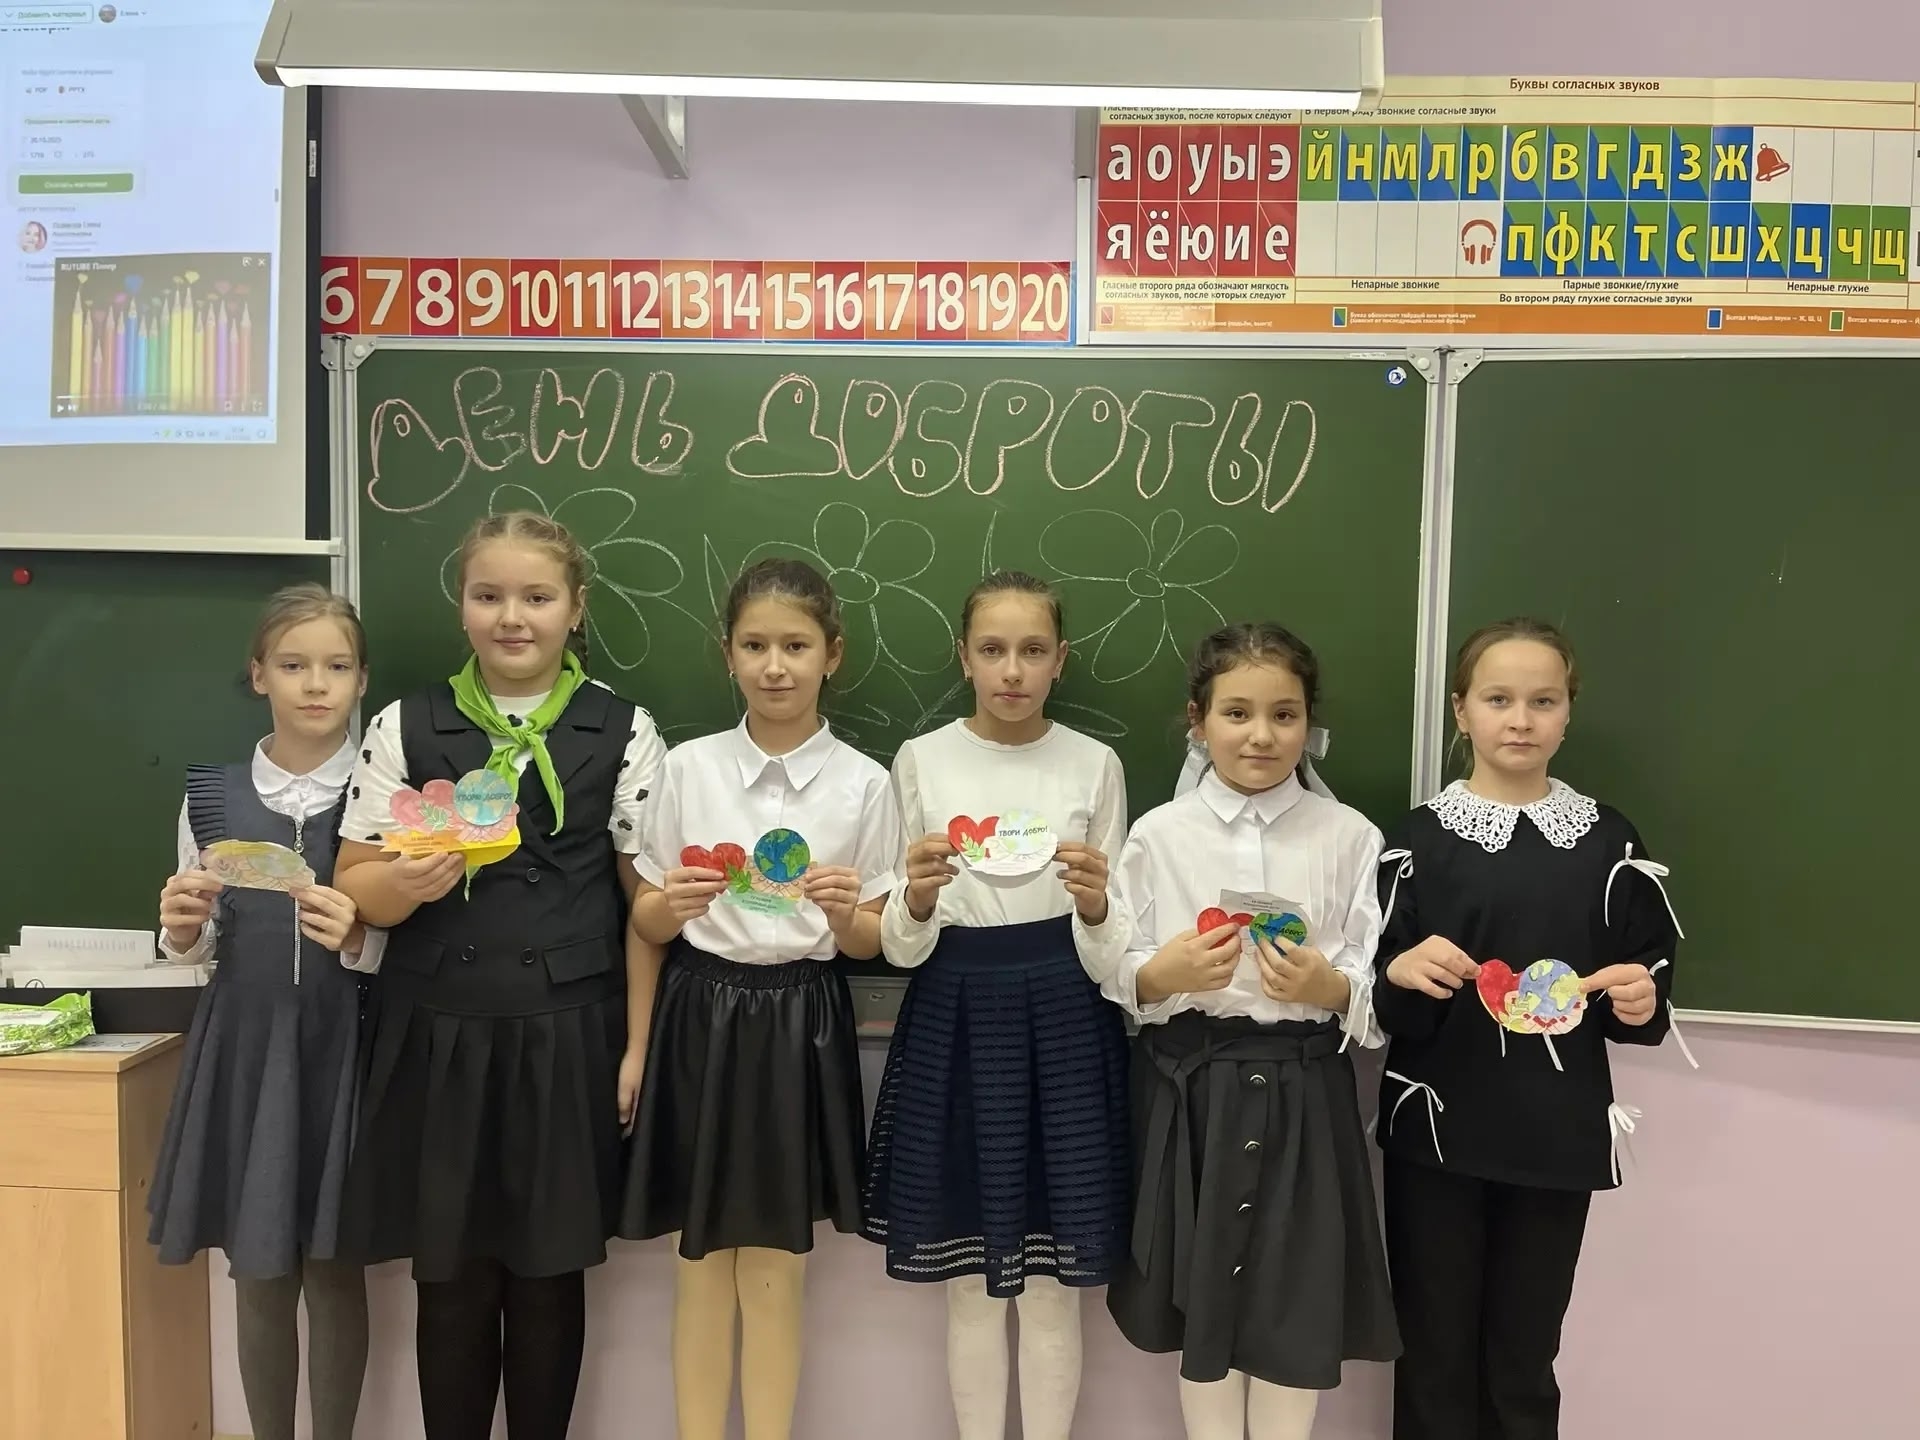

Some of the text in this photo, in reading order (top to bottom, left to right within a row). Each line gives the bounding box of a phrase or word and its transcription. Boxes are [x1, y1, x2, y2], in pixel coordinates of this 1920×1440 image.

[1510, 78, 1660, 93] Буквы согласных звуков
[1155, 113, 1187, 122] звуков,
[1189, 112, 1214, 120] после
[1217, 112, 1253, 121] которых
[1255, 112, 1292, 121] следуют
[1377, 108, 1415, 116] звонкие
[1418, 107, 1467, 116] согласные
[1469, 107, 1496, 117] звуки
[1306, 129, 1749, 195] й н м л р б в г д з ж
[1106, 143, 1292, 196] а о у ы э
[1106, 210, 1290, 262] я ё ю и е
[1507, 224, 1535, 262] п
[1545, 211, 1580, 276] ф
[1589, 224, 1618, 262] к
[1633, 224, 1659, 262] т
[1676, 224, 1698, 262] с
[1710, 225, 1746, 263] ш
[1756, 225, 1784, 264] х
[1795, 226, 1823, 274] ц
[1837, 227, 1863, 266] ч
[1872, 228, 1906, 277] щ
[1102, 281, 1290, 292] Гласные второго ряда обозначают мягкость
[1351, 280, 1440, 291] Непарные звонкие
[1563, 280, 1680, 291] Парные звонкие/глухие
[1787, 281, 1870, 294] Непарные глухие
[320, 266, 1069, 333] 6 7 8 9 10 11 12 13 14 15 16 17 18 19 20
[1105, 291, 1287, 301] согласных звуков, после которых следуют
[1499, 293, 1693, 305] Во втором ряду глухие согласные звуки
[368, 366, 1317, 513] ДЕНЬ ДОБРОТЫ
[1022, 825, 1048, 837] ДОБРО!
